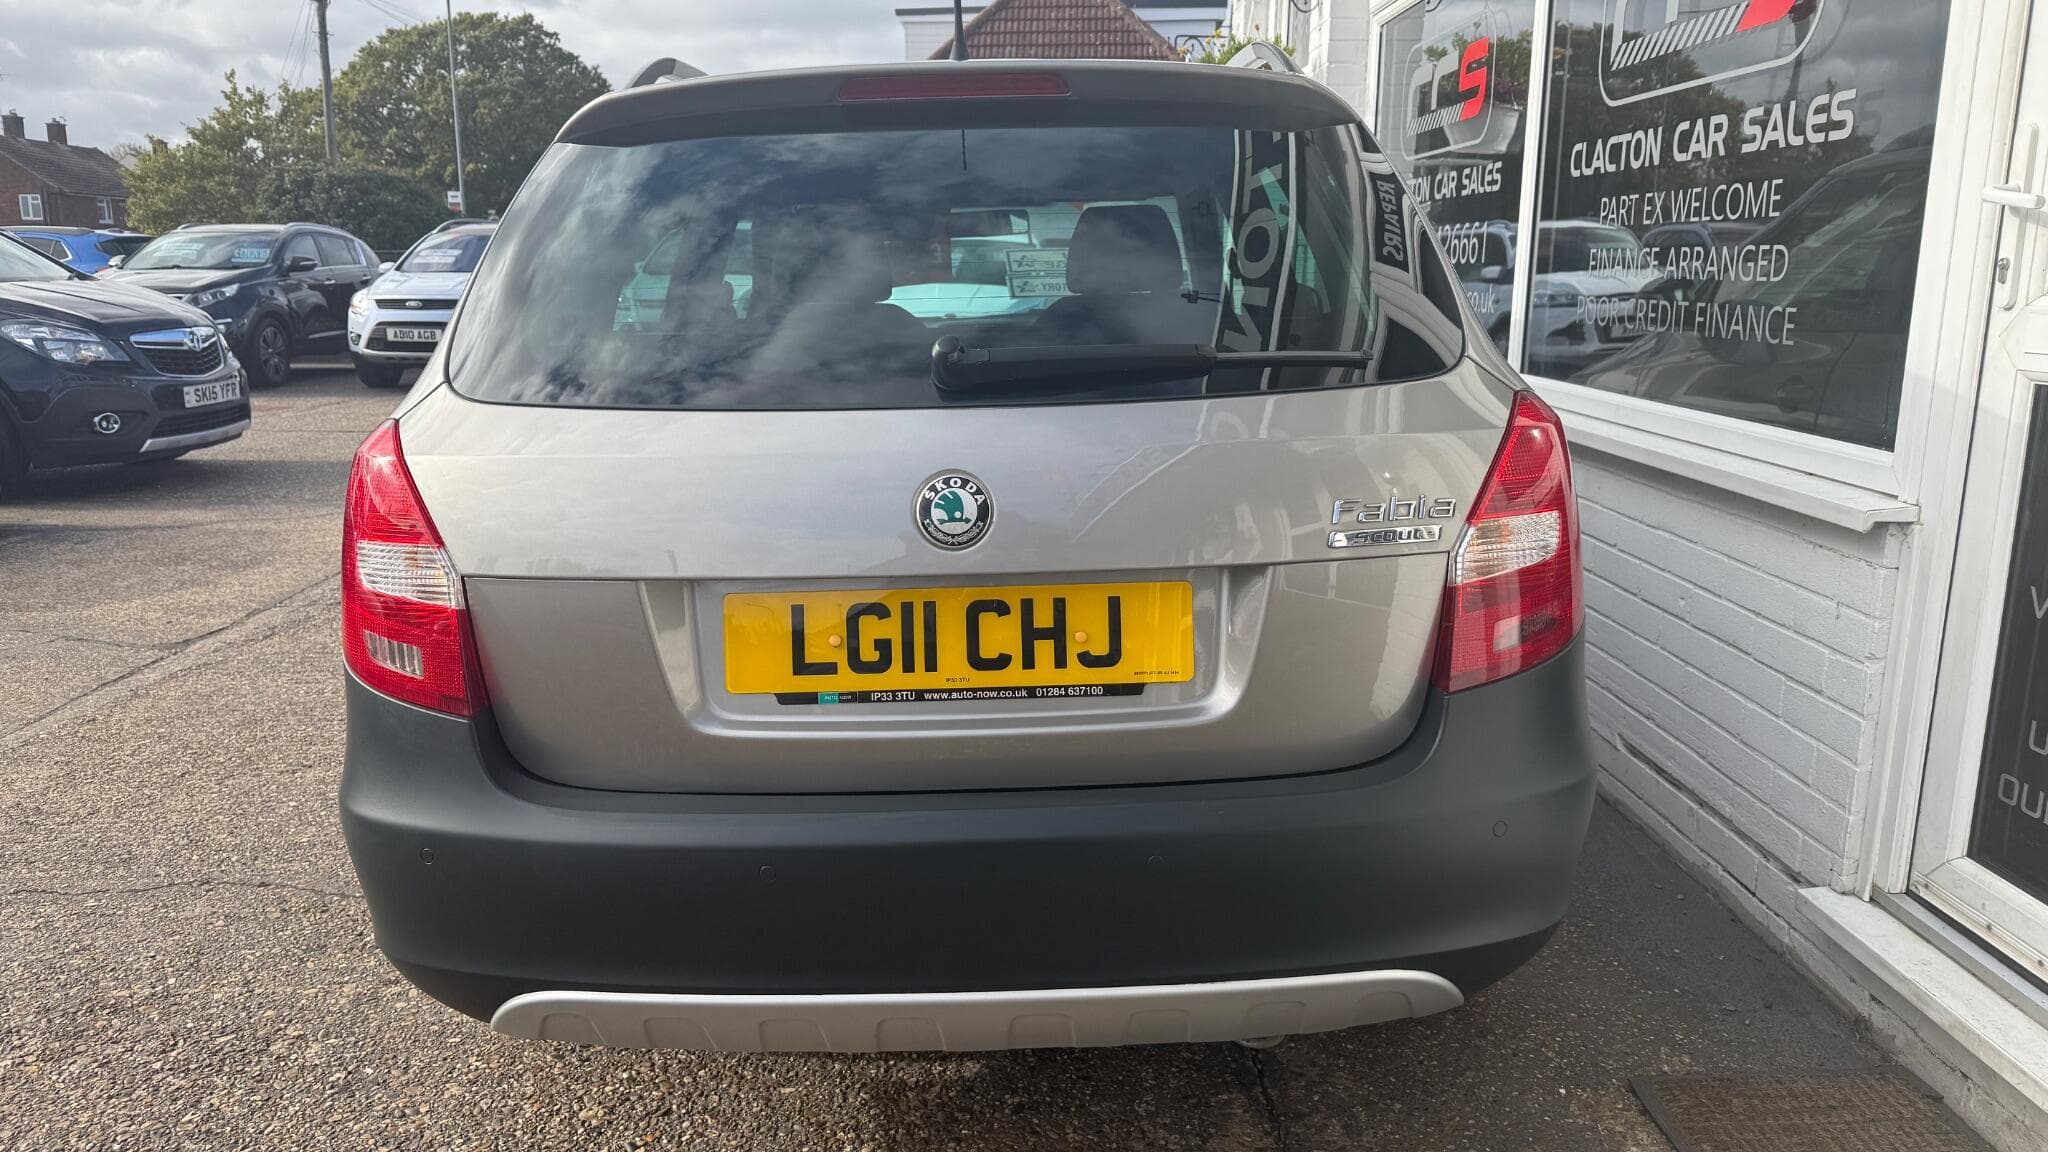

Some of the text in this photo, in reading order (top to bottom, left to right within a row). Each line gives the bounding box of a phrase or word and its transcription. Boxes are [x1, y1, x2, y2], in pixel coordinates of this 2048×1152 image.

[1570, 89, 1857, 177] CLACTON CAR SALES
[1434, 171, 1457, 200] CAR
[1461, 161, 1502, 196] SALES
[1600, 179, 1783, 226] PART EX WELCOME
[1437, 221, 1488, 264] 26661
[1588, 245, 1789, 282] FINANCE ARRANGED
[417, 329, 437, 341] AGB
[1576, 295, 1797, 345] POOR CREDIT FINANCE
[194, 382, 237, 403] SK15 YFR
[1332, 494, 1457, 524] Fabia
[790, 595, 1122, 677] LG11 CHJ
[871, 686, 1103, 702] IP33 3TU www.auto-now.co.uk 01284 637100
